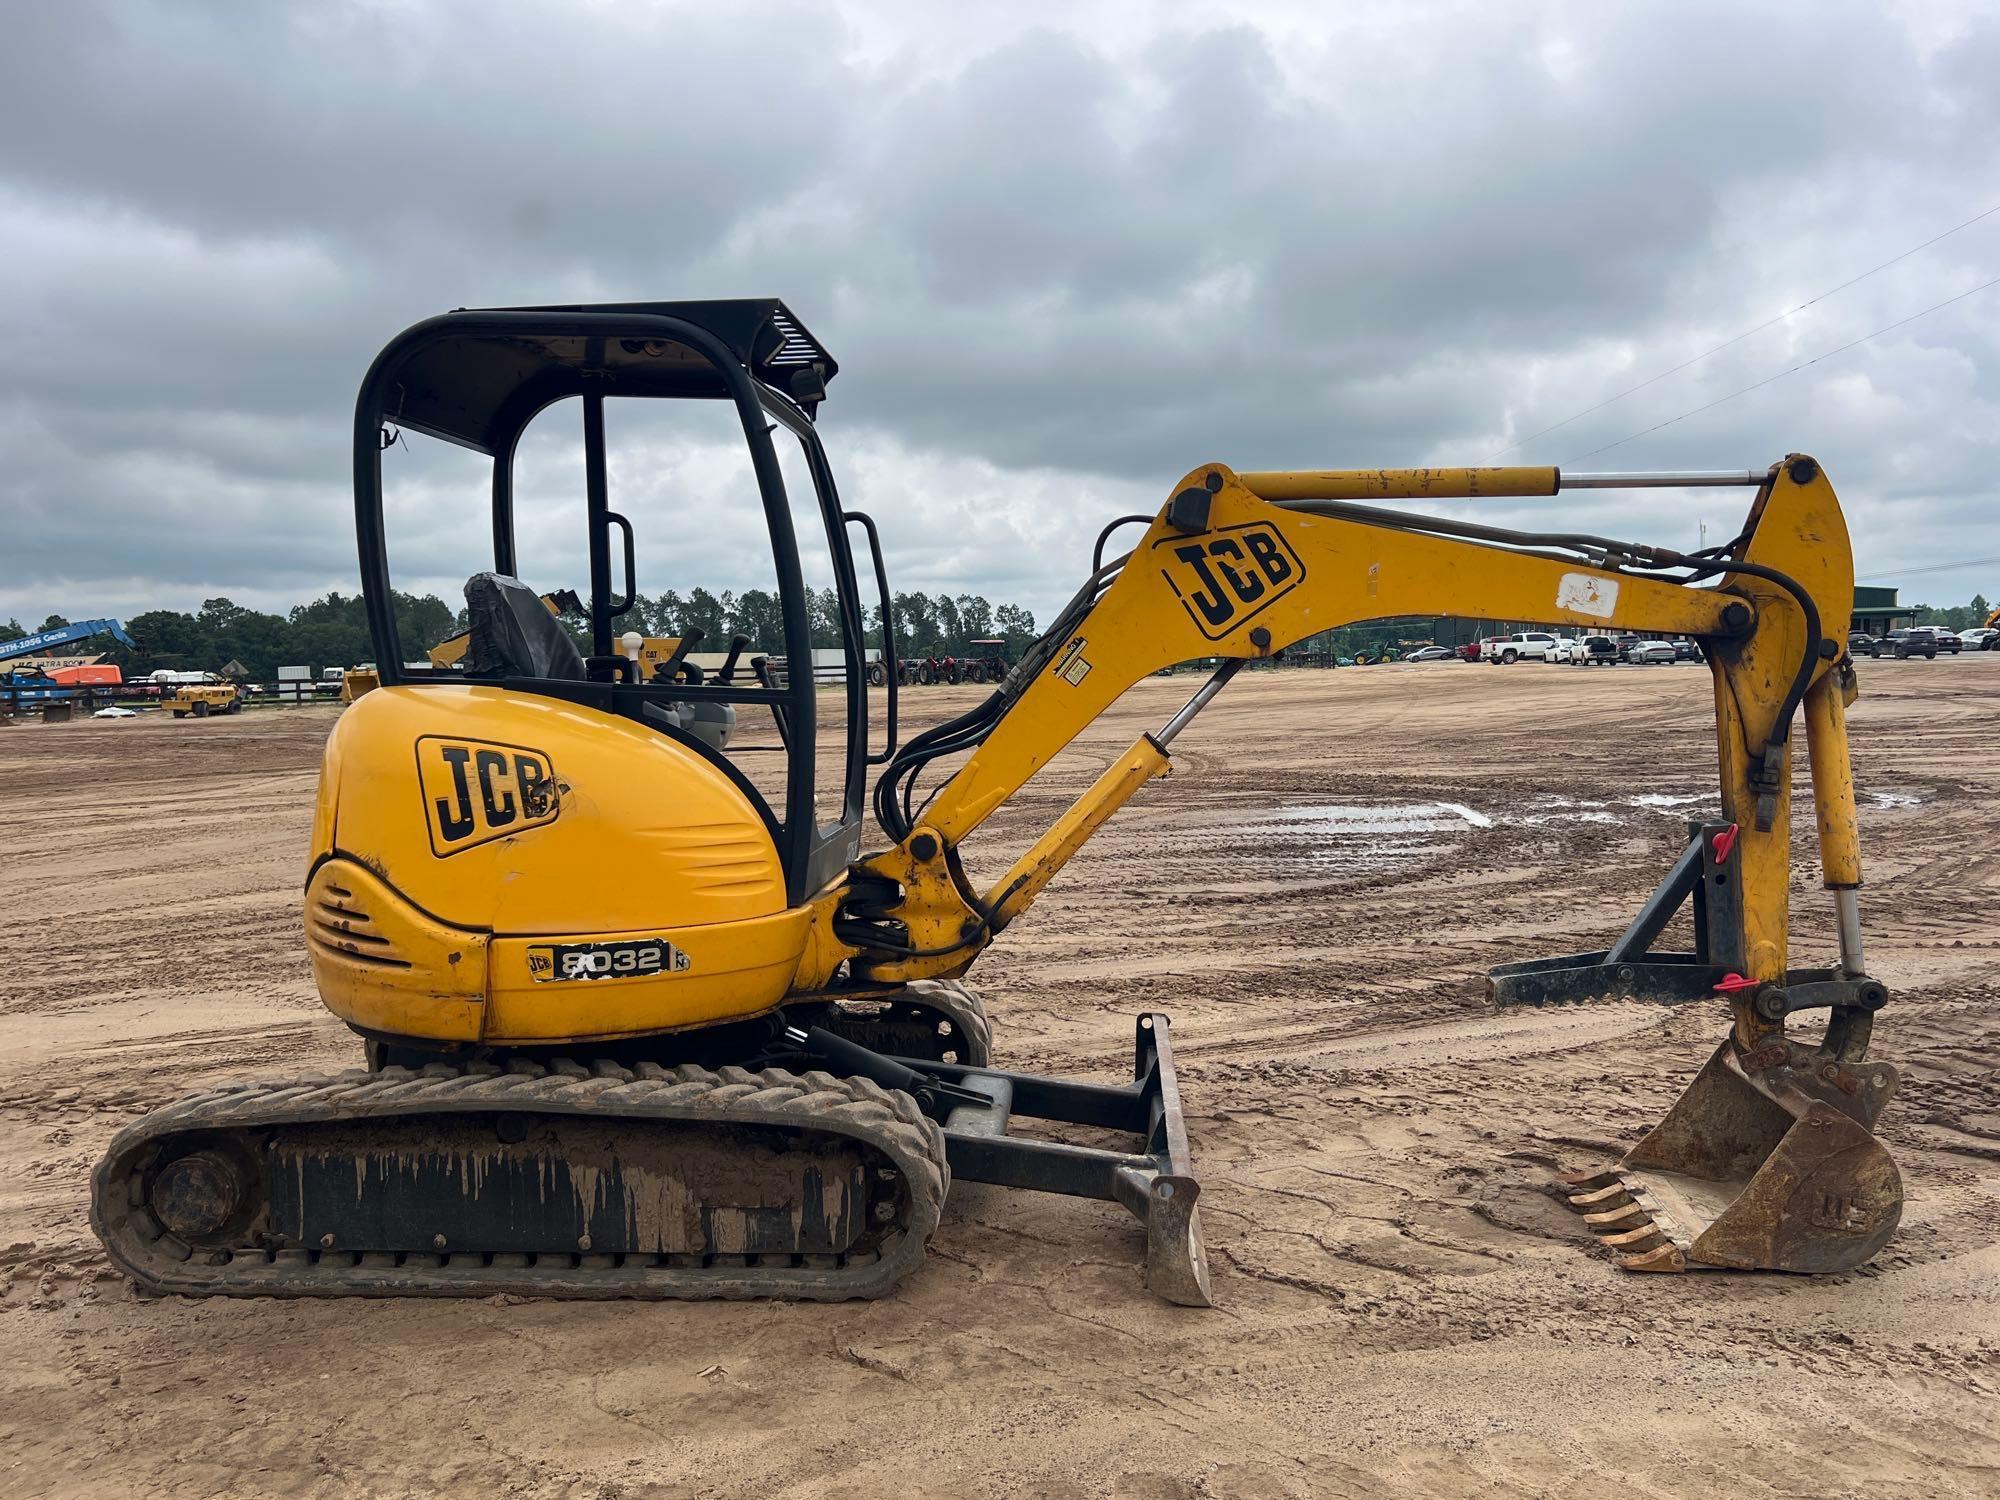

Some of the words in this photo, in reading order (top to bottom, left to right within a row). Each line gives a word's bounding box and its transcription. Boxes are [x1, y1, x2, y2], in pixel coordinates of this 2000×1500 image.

[1174, 533, 1292, 625] JCB
[43, 632, 67, 642] Genie
[435, 745, 552, 841] JCB
[529, 954, 550, 972] JCB
[562, 947, 661, 974] 8032
